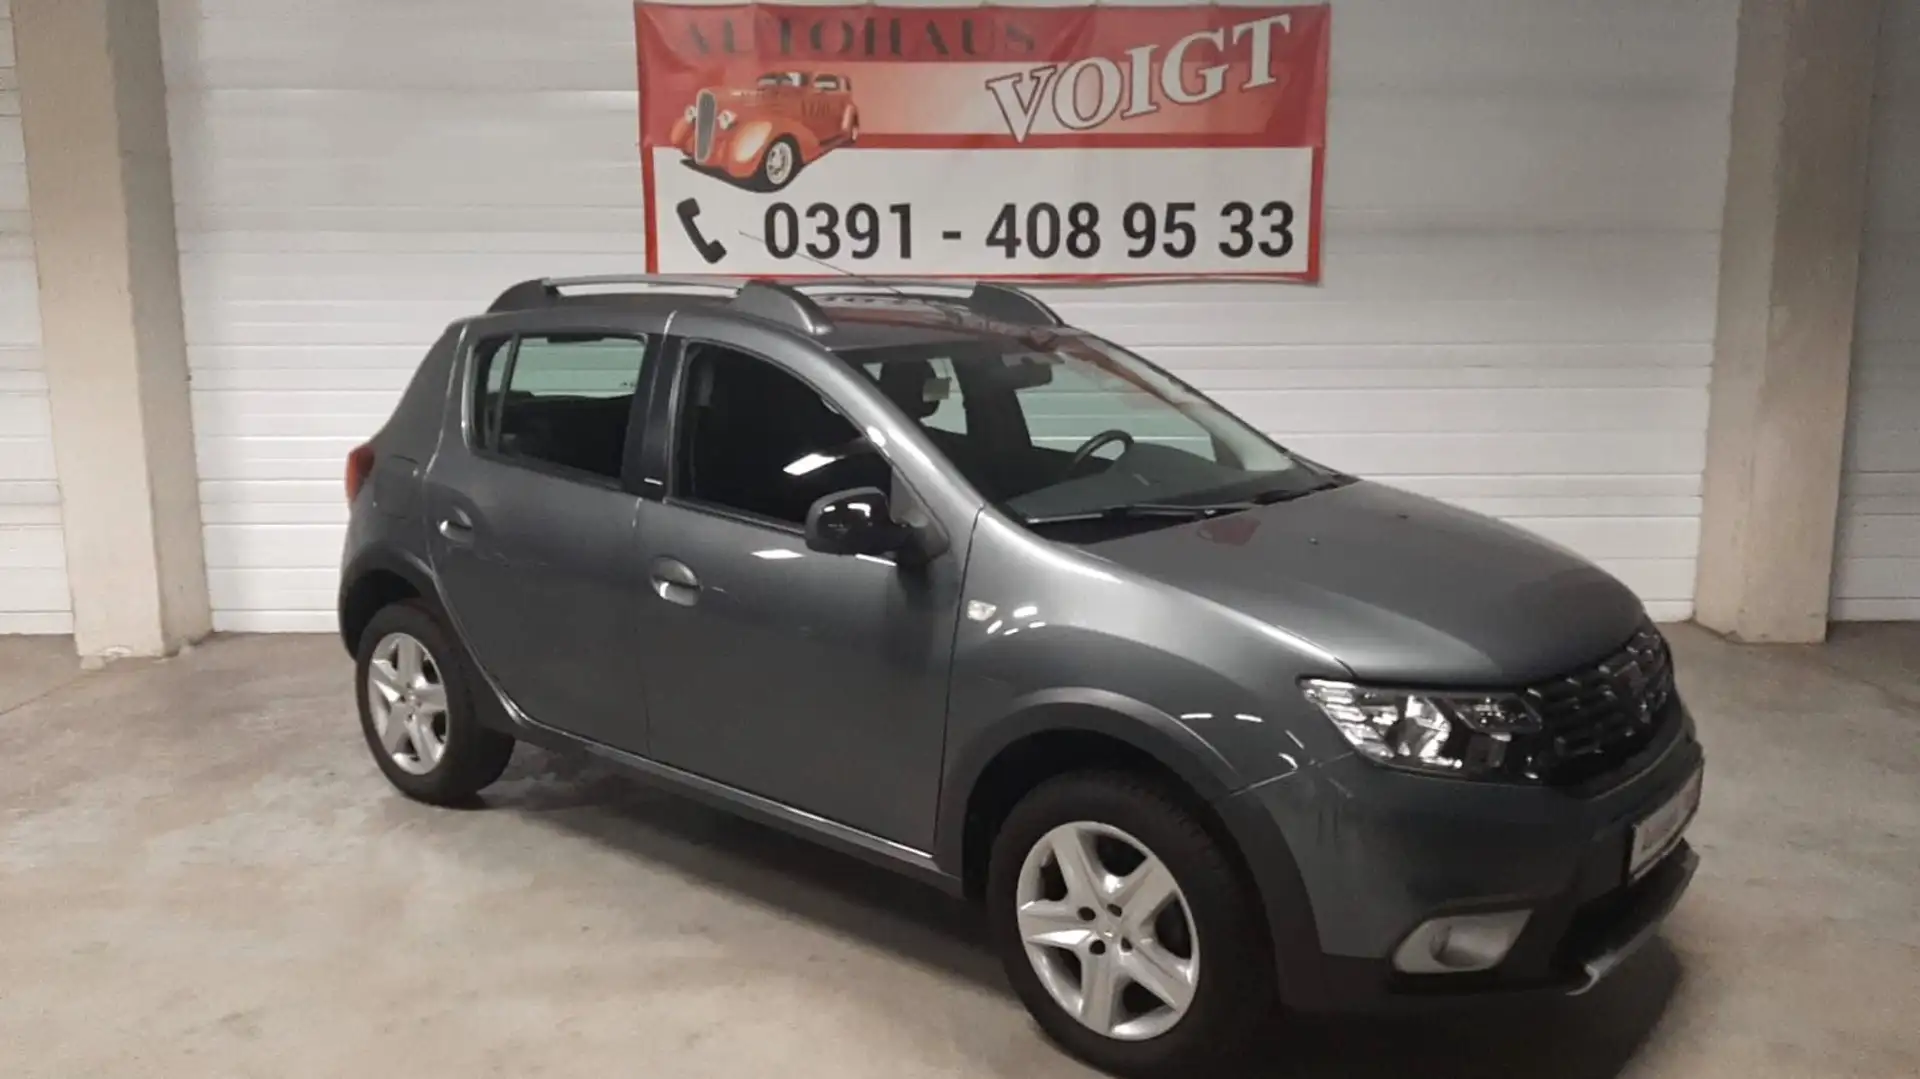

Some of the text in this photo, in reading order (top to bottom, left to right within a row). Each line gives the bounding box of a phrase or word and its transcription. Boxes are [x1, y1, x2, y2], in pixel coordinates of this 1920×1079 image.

[679, 15, 1036, 56] AUTOHAUS
[986, 14, 1292, 143] VOIGT
[764, 201, 1295, 260] 0391 - 408 95 33
